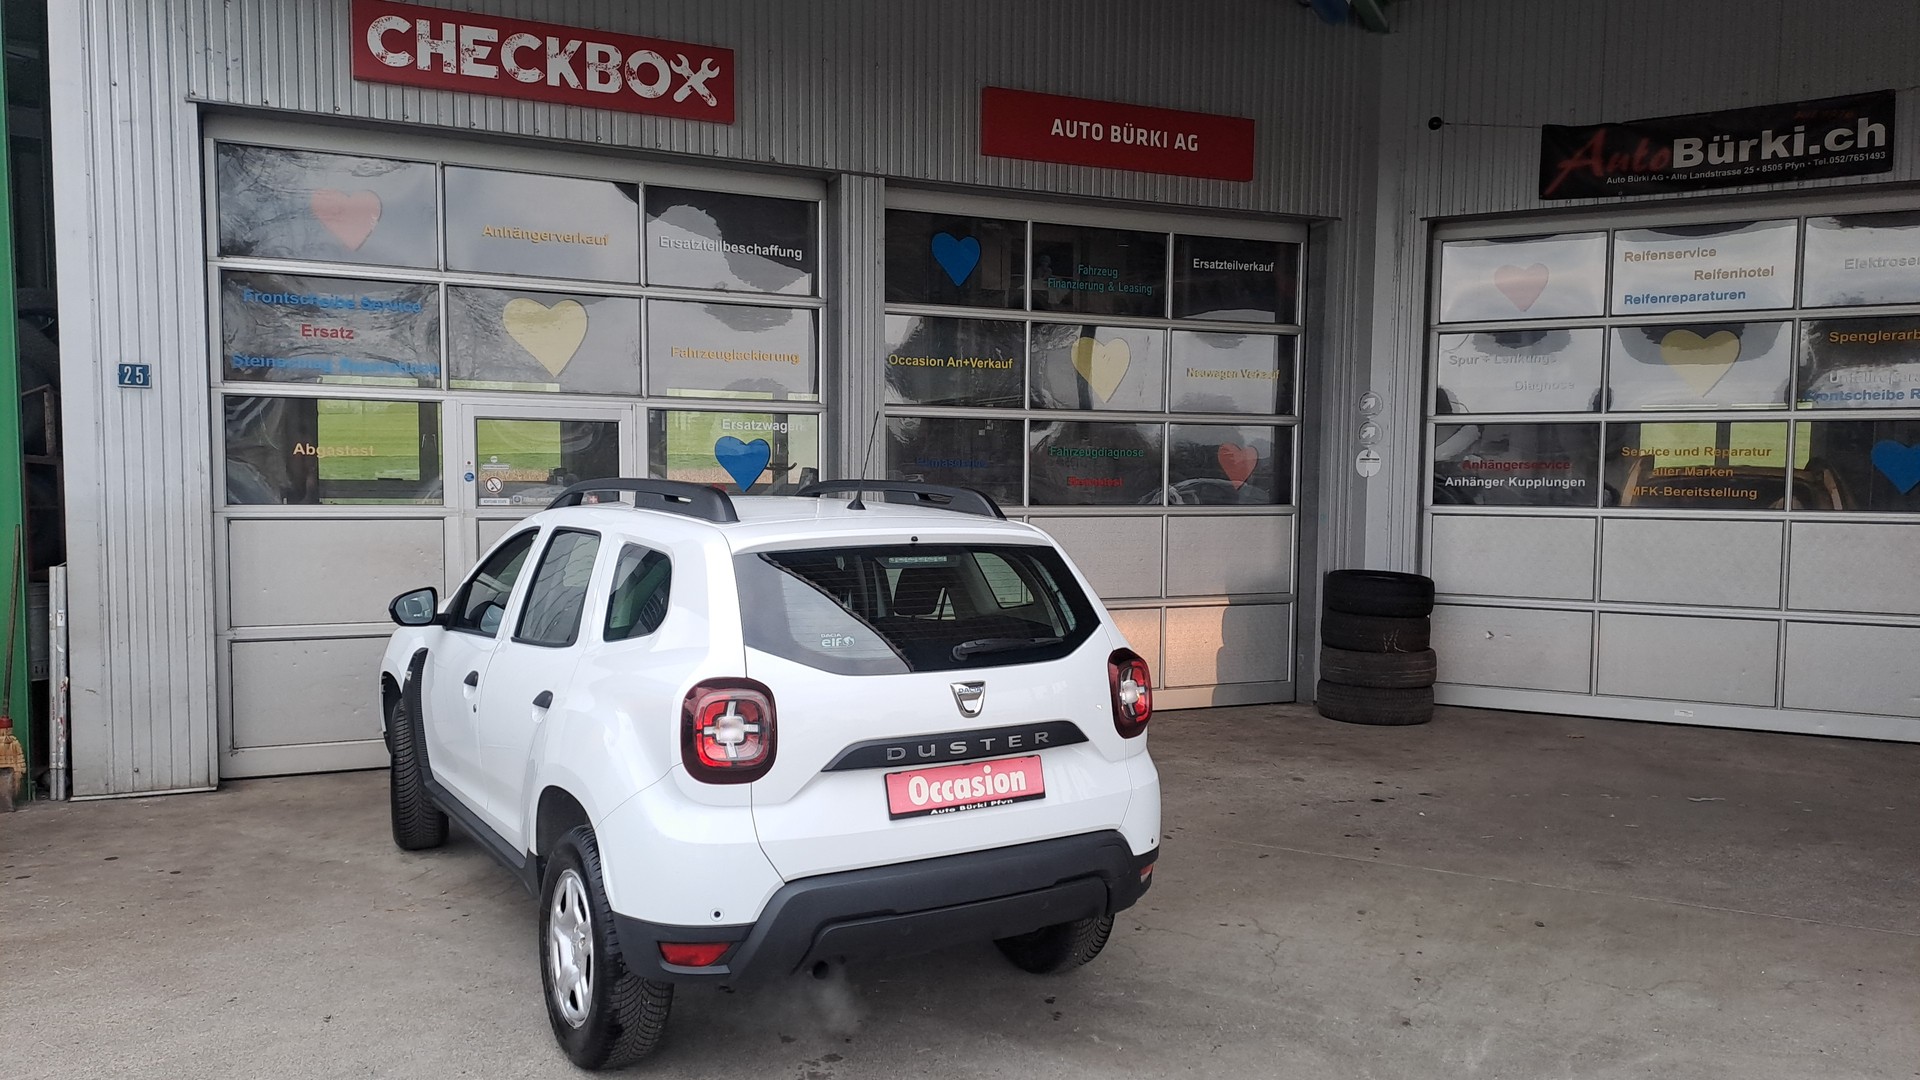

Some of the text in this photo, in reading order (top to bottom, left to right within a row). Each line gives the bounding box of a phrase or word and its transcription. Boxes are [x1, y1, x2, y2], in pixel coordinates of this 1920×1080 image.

[366, 14, 720, 107] CHECKBOX
[1051, 118, 1198, 151] AUTO BÜRKI AG
[1606, 176, 1626, 184] Auto
[1627, 174, 1649, 183] Bürki
[1651, 174, 1664, 182] AG
[1671, 172, 1687, 180] Alte
[1689, 168, 1742, 179] Landstrasse
[1743, 166, 1754, 174] 25
[1761, 163, 1783, 172] 8505
[1784, 161, 1805, 171] Pfyn
[482, 223, 610, 247] Anhängerverkauf
[658, 234, 803, 261] Ersatzteilbeschaffung
[1624, 247, 1717, 262] Reifenservice
[1078, 264, 1118, 279] Fahrzeug
[1193, 258, 1275, 272] Ersatzteilverkauf
[1694, 266, 1774, 280] Reifenhotel
[1047, 277, 1152, 296] Finanzierung & Leasing
[1624, 291, 1746, 305] Reifenreparaturen
[301, 324, 354, 340] Ersatz
[671, 346, 801, 366] Fahrzeuglackierung
[888, 354, 1013, 369] Occasion An+Verkauf
[1449, 355, 1480, 367] Spur
[124, 365, 144, 384] 25
[292, 442, 375, 458] Abgastest
[1048, 446, 1144, 459] Fahrzeugdiagnose
[1621, 446, 1772, 459] Service und Reparatur
[1462, 460, 1571, 471] Anhängerservice
[1652, 467, 1734, 477] aller Marken
[1445, 476, 1585, 489] Anhänger Kupplungen
[1631, 486, 1758, 500] MFK-Bereitstellung
[821, 637, 842, 647] elf
[886, 731, 1050, 761] DUSTER
[908, 764, 1027, 806] Occasion
[959, 802, 987, 811] Bürki
